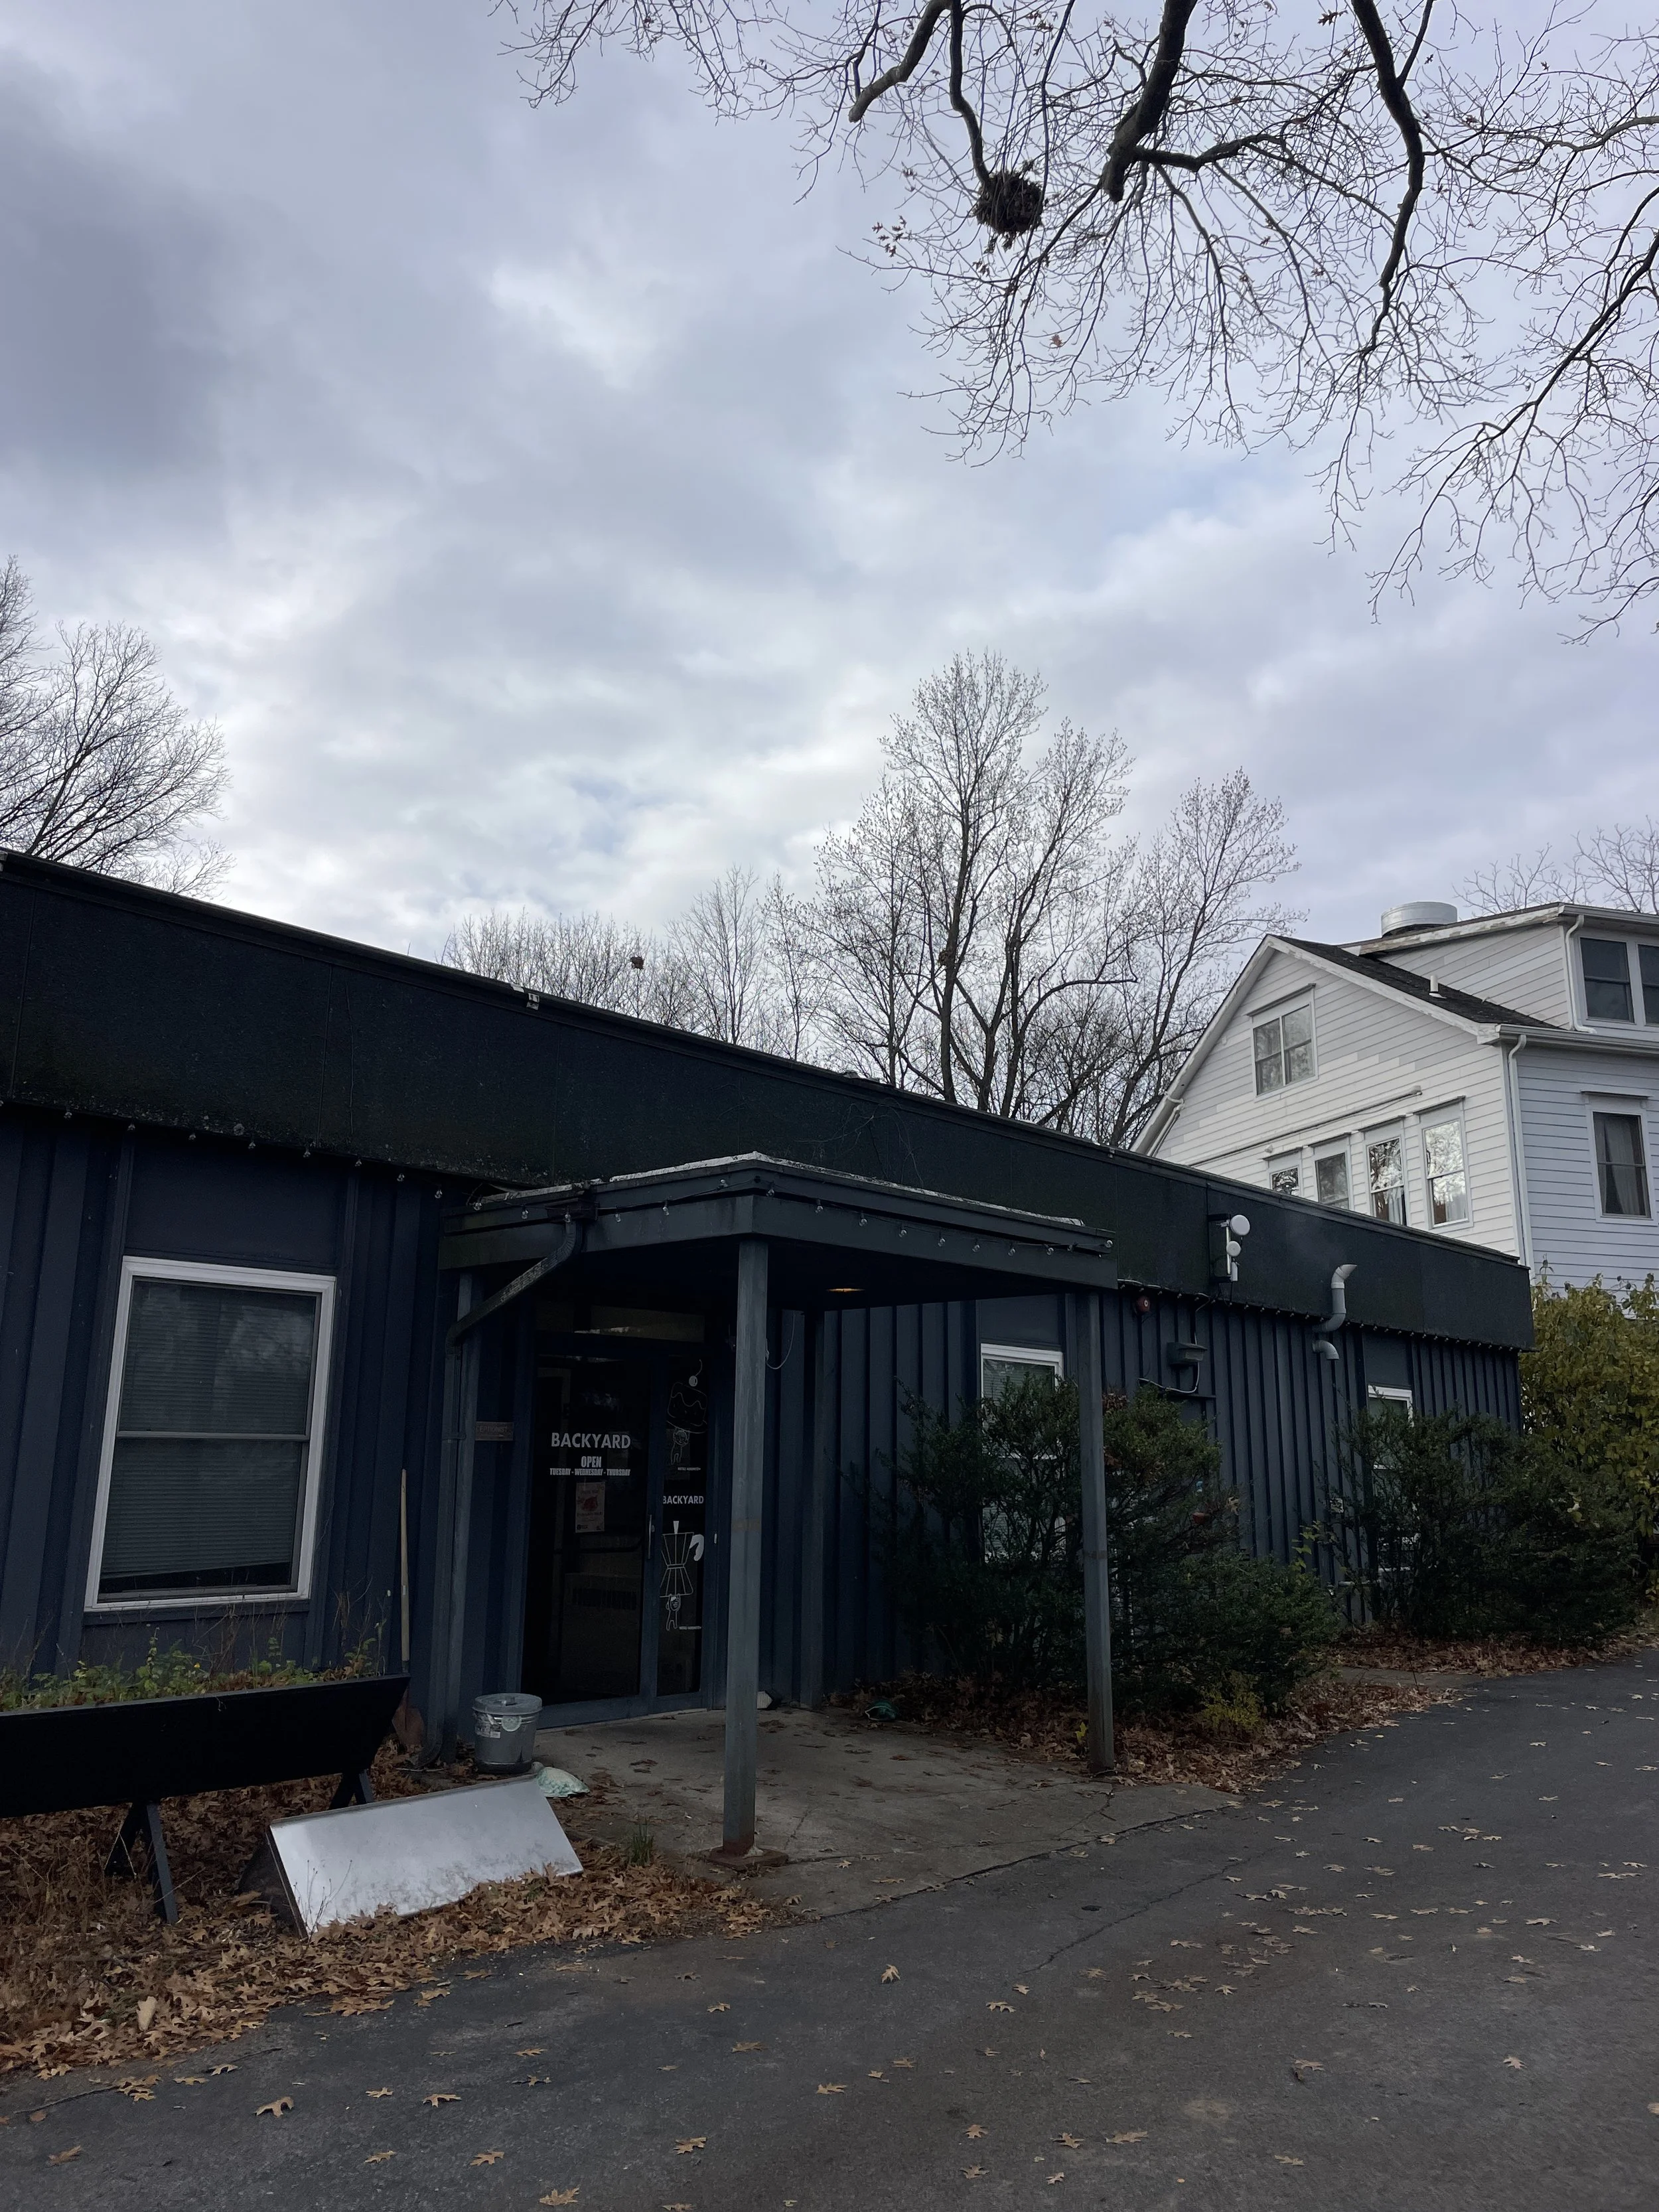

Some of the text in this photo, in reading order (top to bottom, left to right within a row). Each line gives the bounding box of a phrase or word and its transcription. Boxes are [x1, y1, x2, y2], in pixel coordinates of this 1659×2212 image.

[551, 1432, 631, 1449] BACKYARD
[581, 1455, 602, 1468] OPEN
[663, 1495, 704, 1505] BACKYARD
